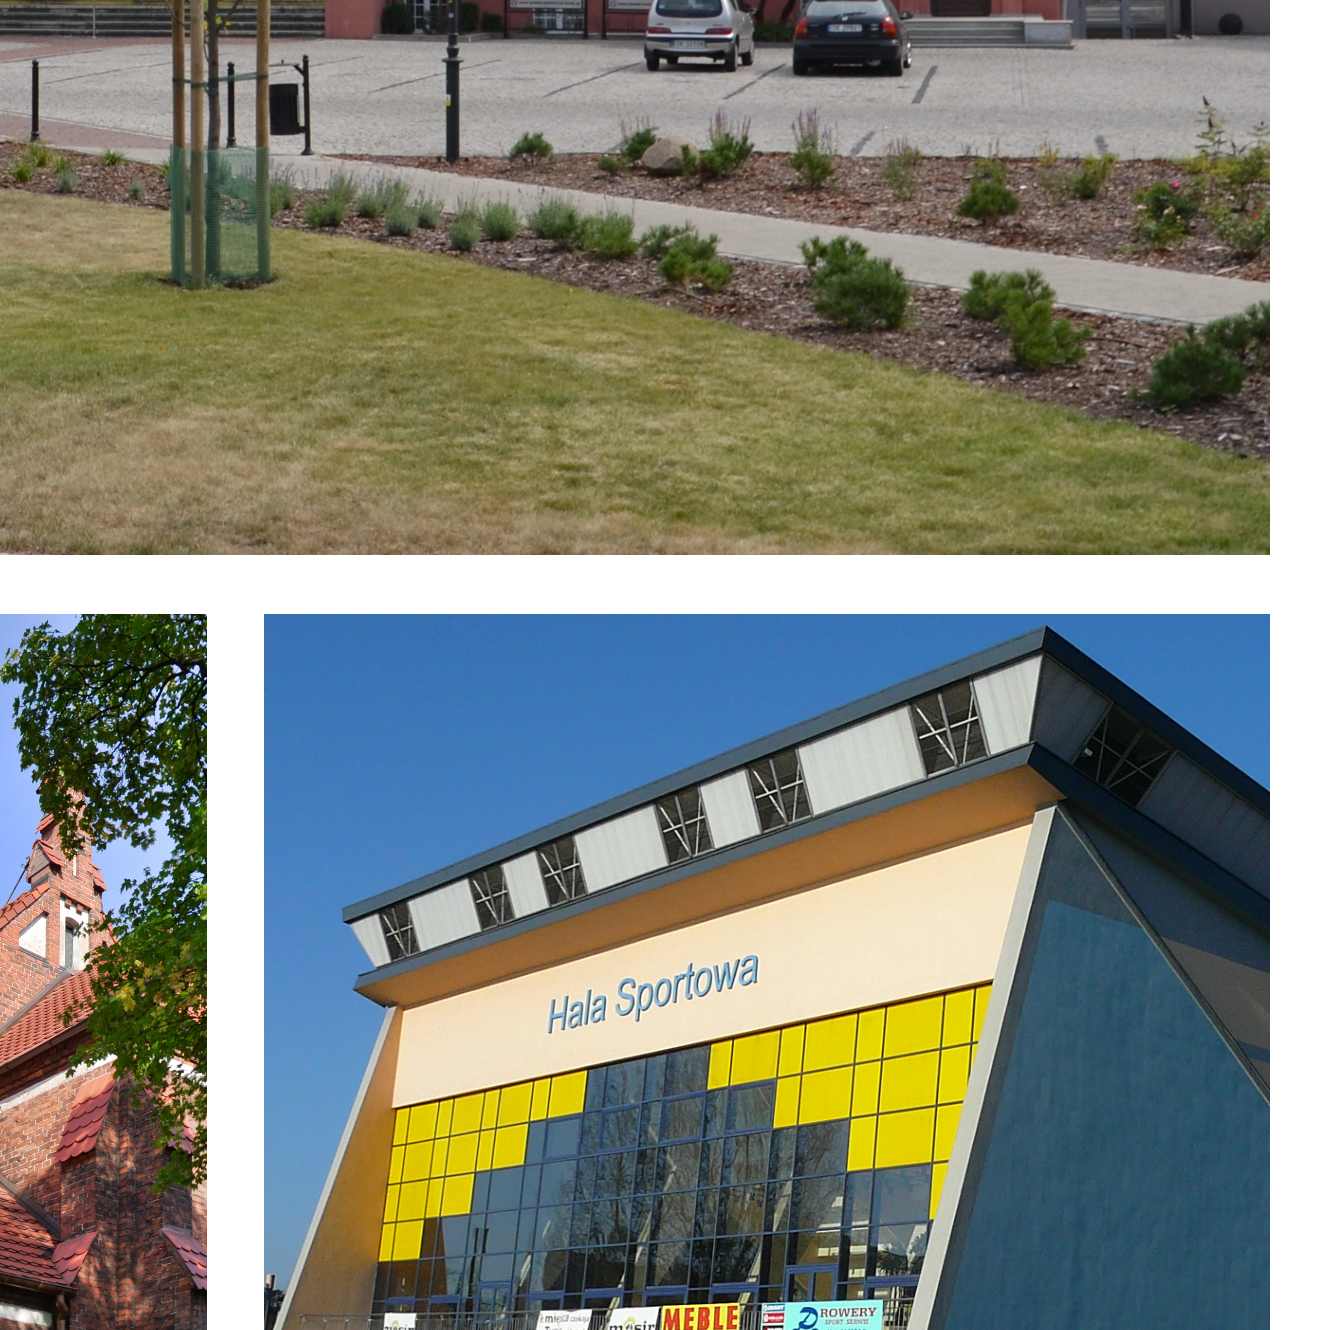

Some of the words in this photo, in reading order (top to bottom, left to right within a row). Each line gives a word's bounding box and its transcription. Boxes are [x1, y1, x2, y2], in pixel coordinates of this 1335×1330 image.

[547, 989, 607, 1034] Hala
[615, 954, 759, 1022] Sportowa
[820, 1307, 877, 1318] ROWERY
